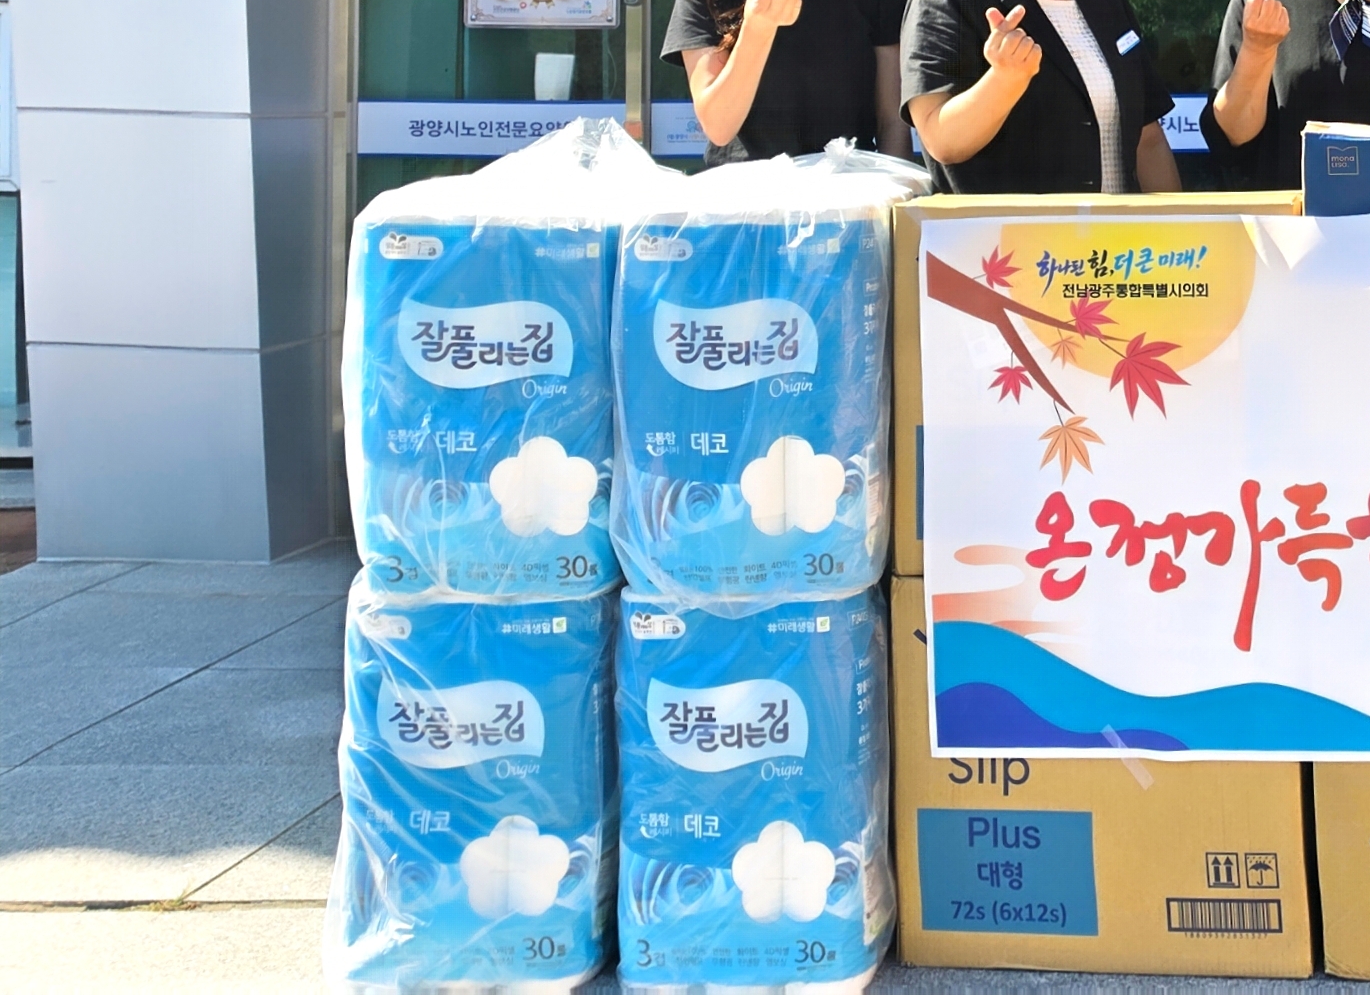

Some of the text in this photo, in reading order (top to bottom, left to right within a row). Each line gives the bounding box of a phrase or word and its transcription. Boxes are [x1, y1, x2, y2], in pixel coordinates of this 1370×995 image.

[1036, 249, 1085, 298] 하나된
[1134, 247, 1155, 273] 큰
[1158, 245, 1208, 271] 미래!
[1062, 283, 1209, 298] 전남광주통합특별시의회
[411, 320, 554, 370] 잘풀리는집
[666, 318, 799, 372] 잘풀리는집
[521, 378, 567, 399] Origin
[769, 377, 814, 398] Origin
[435, 430, 477, 454] 데코
[690, 432, 729, 456] 데코
[501, 622, 551, 635] #미래생활
[767, 621, 815, 634] #미래생활
[388, 700, 525, 750] 잘풀리는집
[659, 699, 789, 753] 잘풀리는집
[496, 759, 541, 779] Origin
[761, 761, 804, 781] Origin
[409, 810, 450, 835] 데코
[684, 814, 722, 839] 데코
[967, 816, 1042, 849] Plus
[976, 860, 1024, 891] 대형
[950, 900, 1068, 928] 72s (6x12s)
